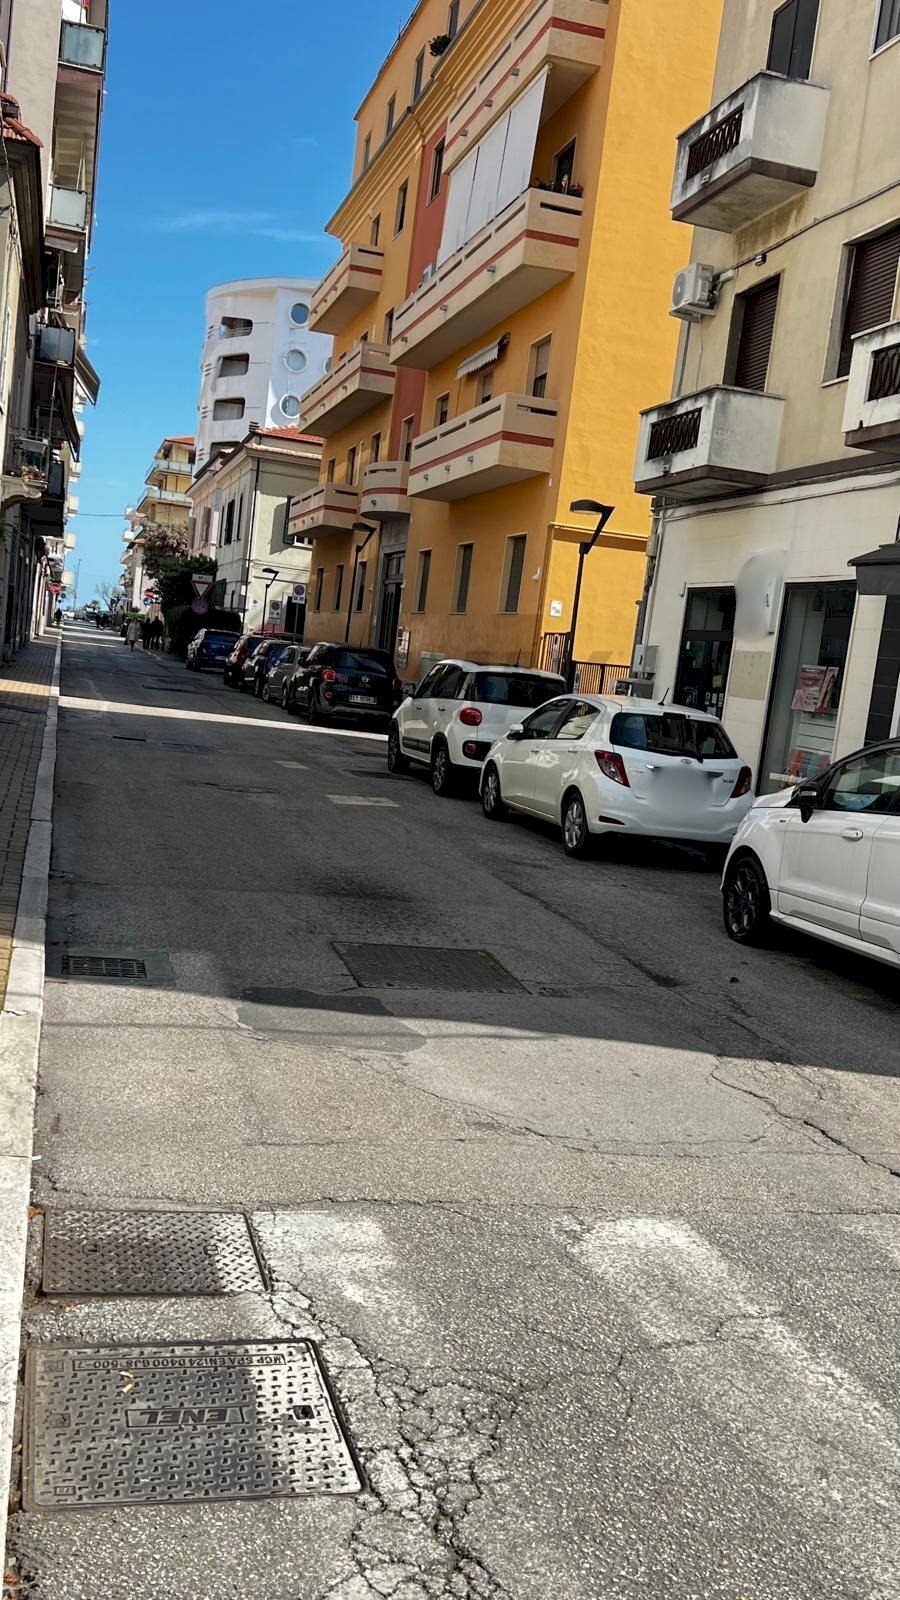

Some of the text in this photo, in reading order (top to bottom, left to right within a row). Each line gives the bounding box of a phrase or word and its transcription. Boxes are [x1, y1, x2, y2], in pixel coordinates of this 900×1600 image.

[152, 1358, 186, 1369] D400
[189, 1357, 226, 1367] EN124
[228, 1356, 253, 1366] SPA
[257, 1355, 282, 1365] MCP
[139, 1408, 228, 1425] ENEL
